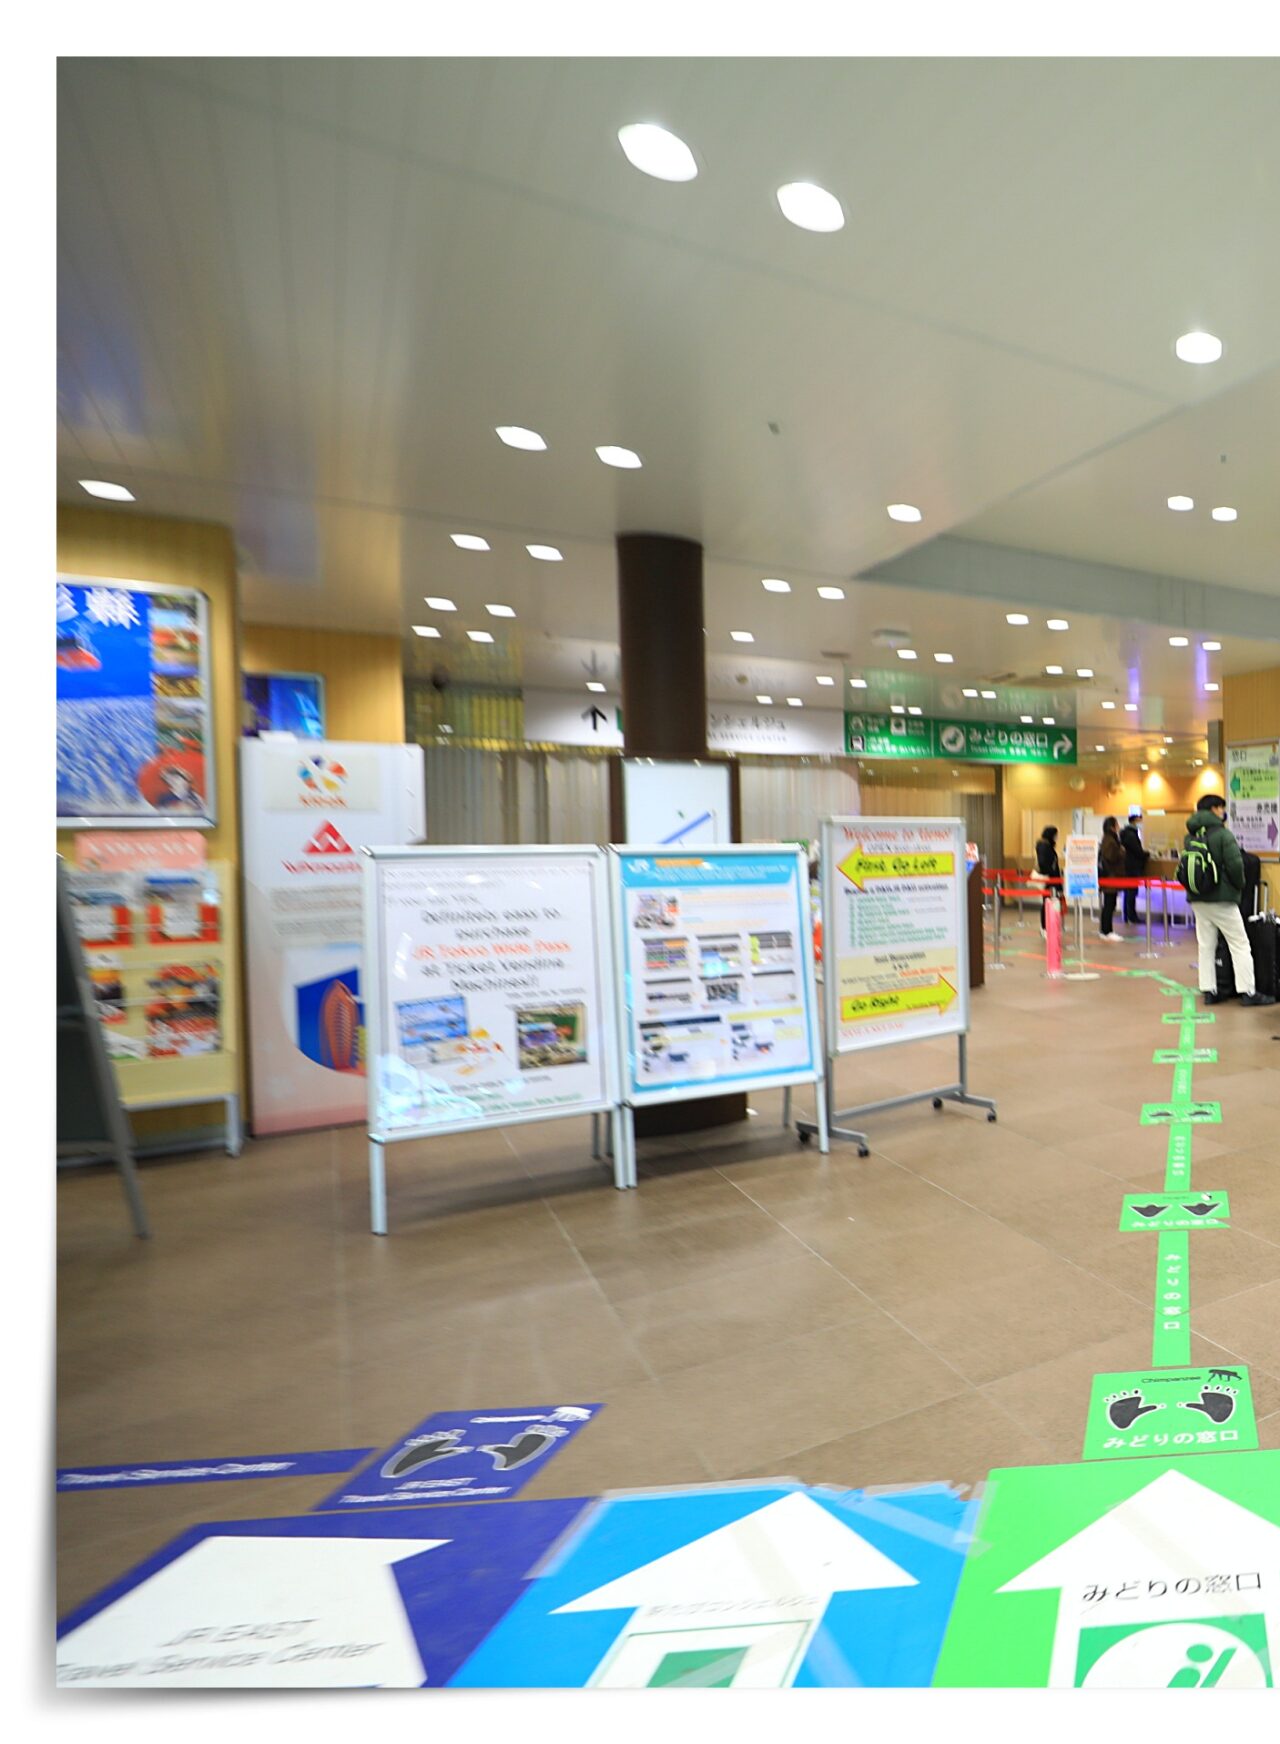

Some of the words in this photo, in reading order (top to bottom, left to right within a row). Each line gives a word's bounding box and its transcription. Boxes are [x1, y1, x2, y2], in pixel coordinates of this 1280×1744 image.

[1141, 1376, 1202, 1384] Chimpanzee
[1103, 1429, 1239, 1449] みどりの窓口
[1082, 1572, 1261, 1602] みどりの窓口
[139, 1652, 272, 1675] Service
[266, 1640, 385, 1665] Center
